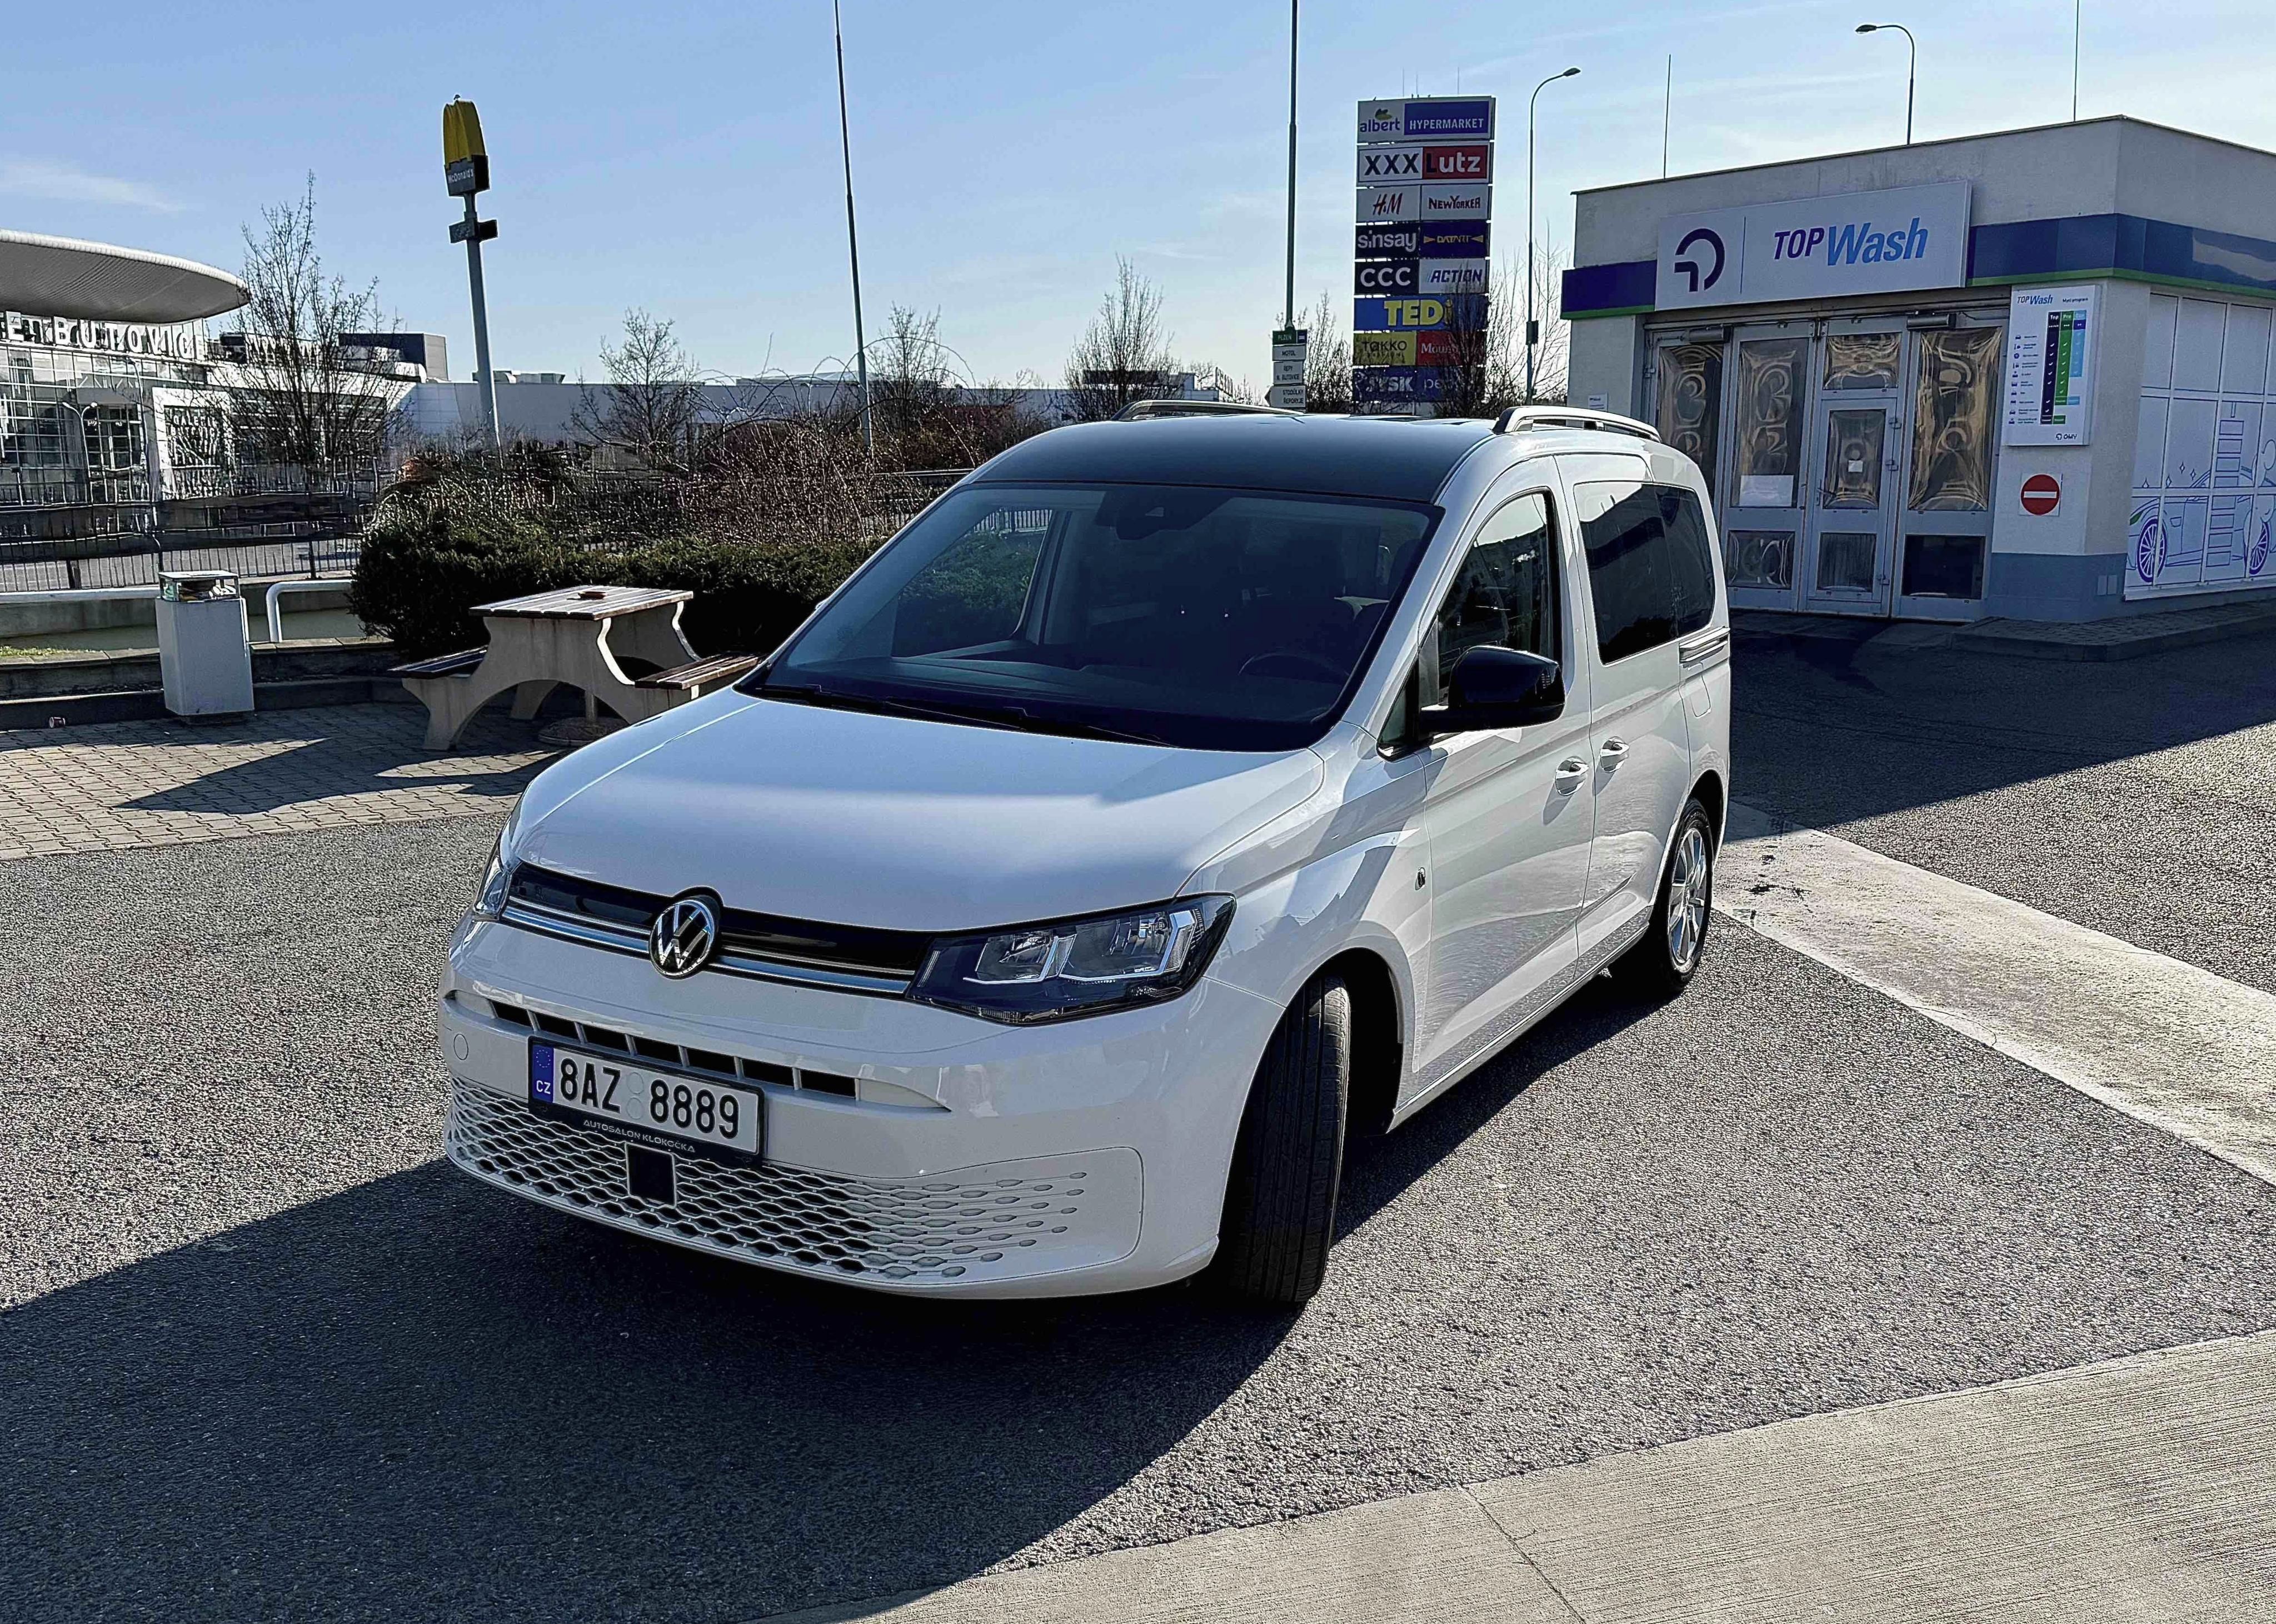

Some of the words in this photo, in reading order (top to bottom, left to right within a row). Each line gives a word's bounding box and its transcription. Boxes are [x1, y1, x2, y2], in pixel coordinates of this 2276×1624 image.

[1360, 118, 1400, 132] albert
[1410, 118, 1484, 130] HYPERMARKET
[1357, 230, 1416, 252] sinsay
[1360, 267, 1411, 287] CCC
[1429, 269, 1483, 283] ACTION
[536, 1080, 551, 1095] CZ
[560, 1058, 621, 1113] 8AZ
[650, 1078, 740, 1140] 8889
[583, 1120, 640, 1138] AUTOSALON
